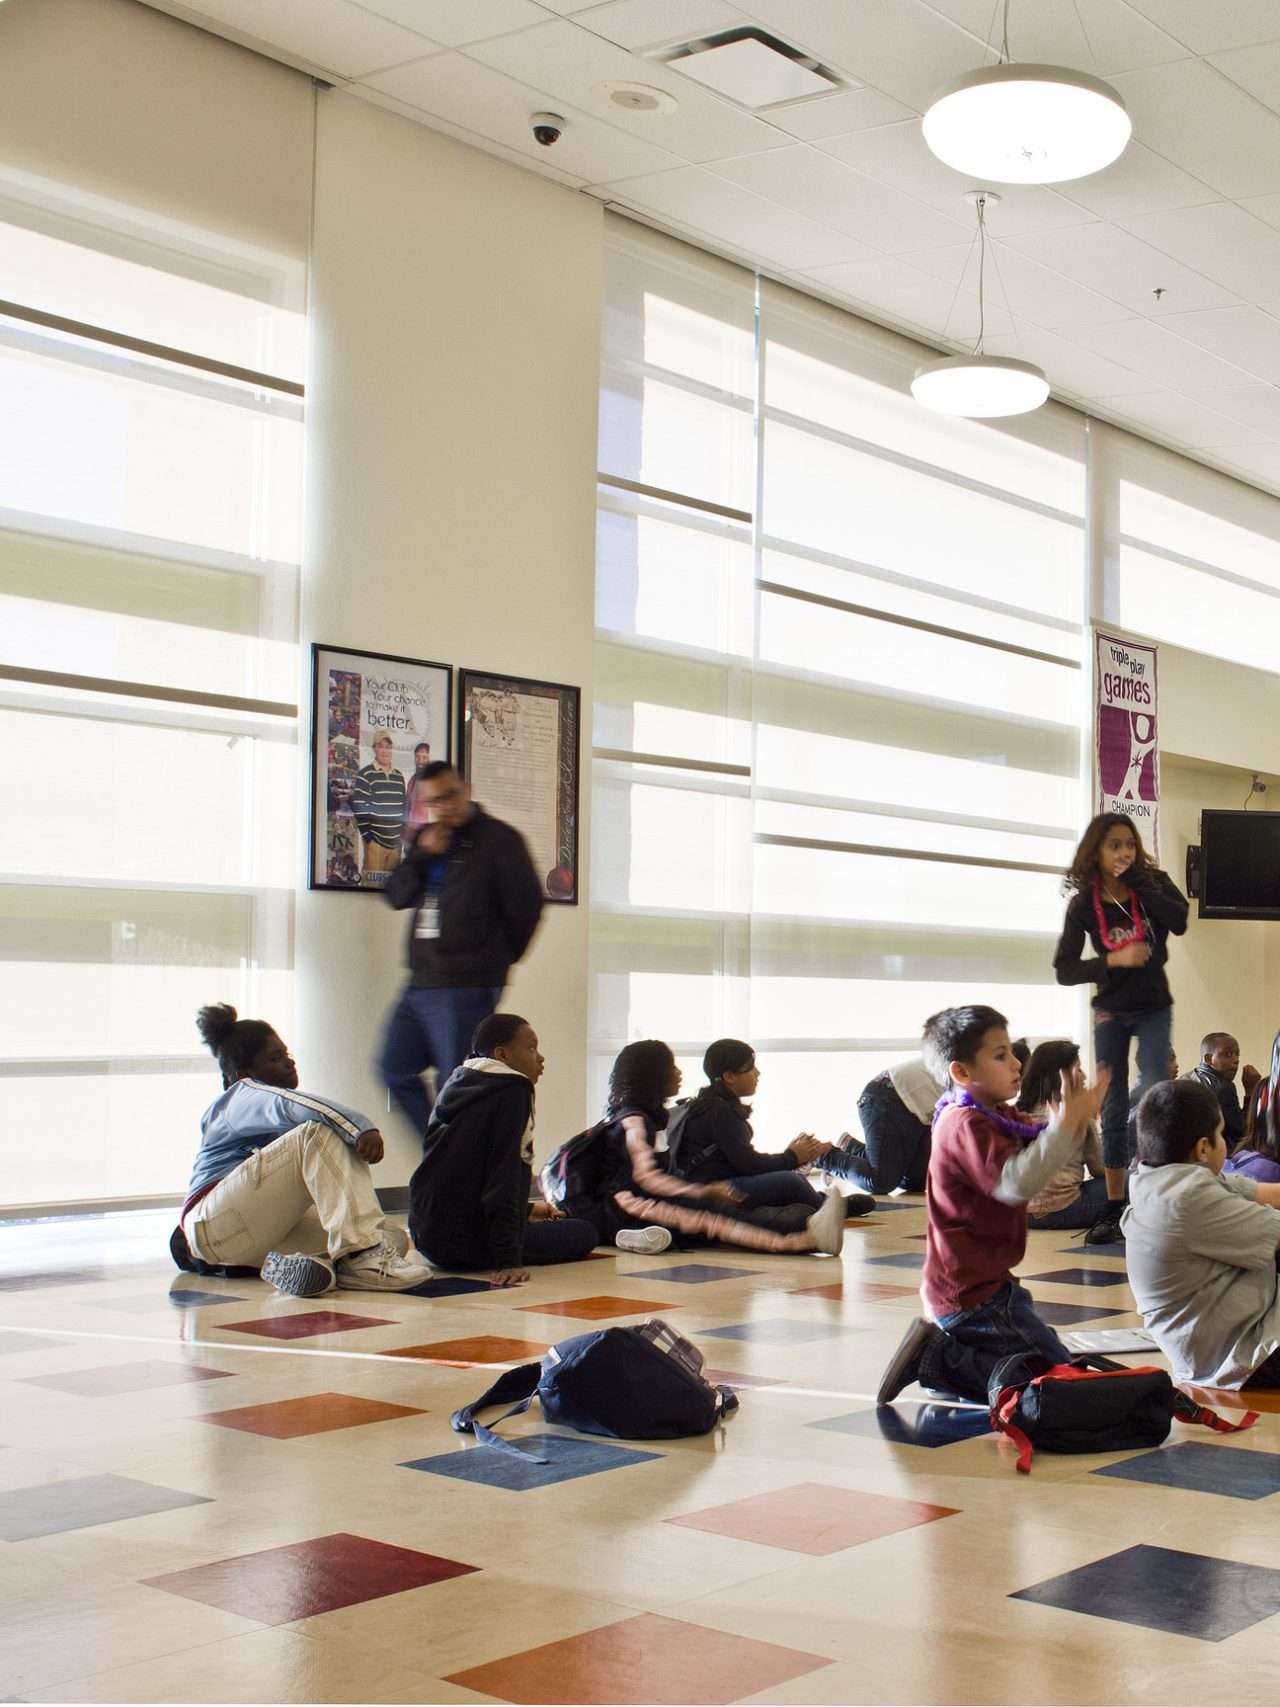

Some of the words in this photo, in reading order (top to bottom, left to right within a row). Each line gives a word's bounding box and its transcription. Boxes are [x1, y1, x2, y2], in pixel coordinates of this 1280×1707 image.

[1110, 646, 1129, 667] triple
[1130, 659, 1145, 680] play
[1104, 672, 1151, 704] games
[1111, 800, 1151, 817] CHAMPION
